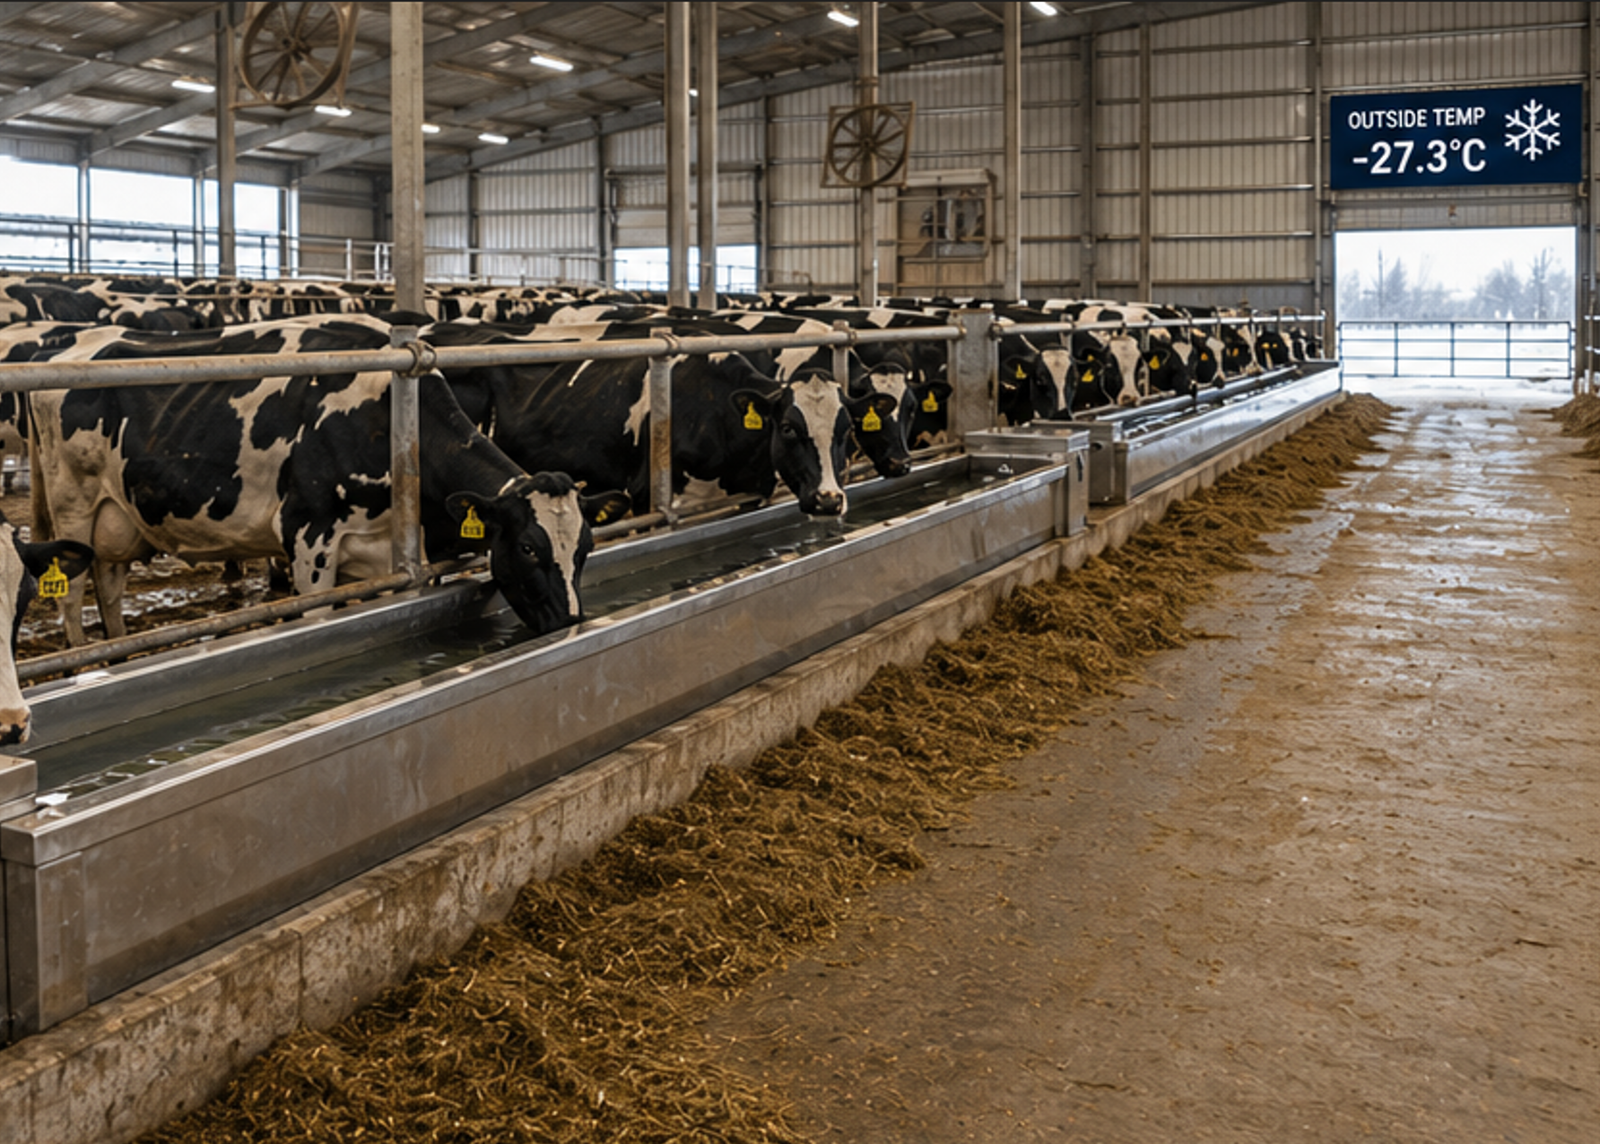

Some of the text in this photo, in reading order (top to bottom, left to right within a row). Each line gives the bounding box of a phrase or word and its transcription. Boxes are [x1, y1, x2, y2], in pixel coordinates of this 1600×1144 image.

[1348, 107, 1486, 129] OUTSIDE TEMP
[1353, 138, 1486, 174] -27.3°C
